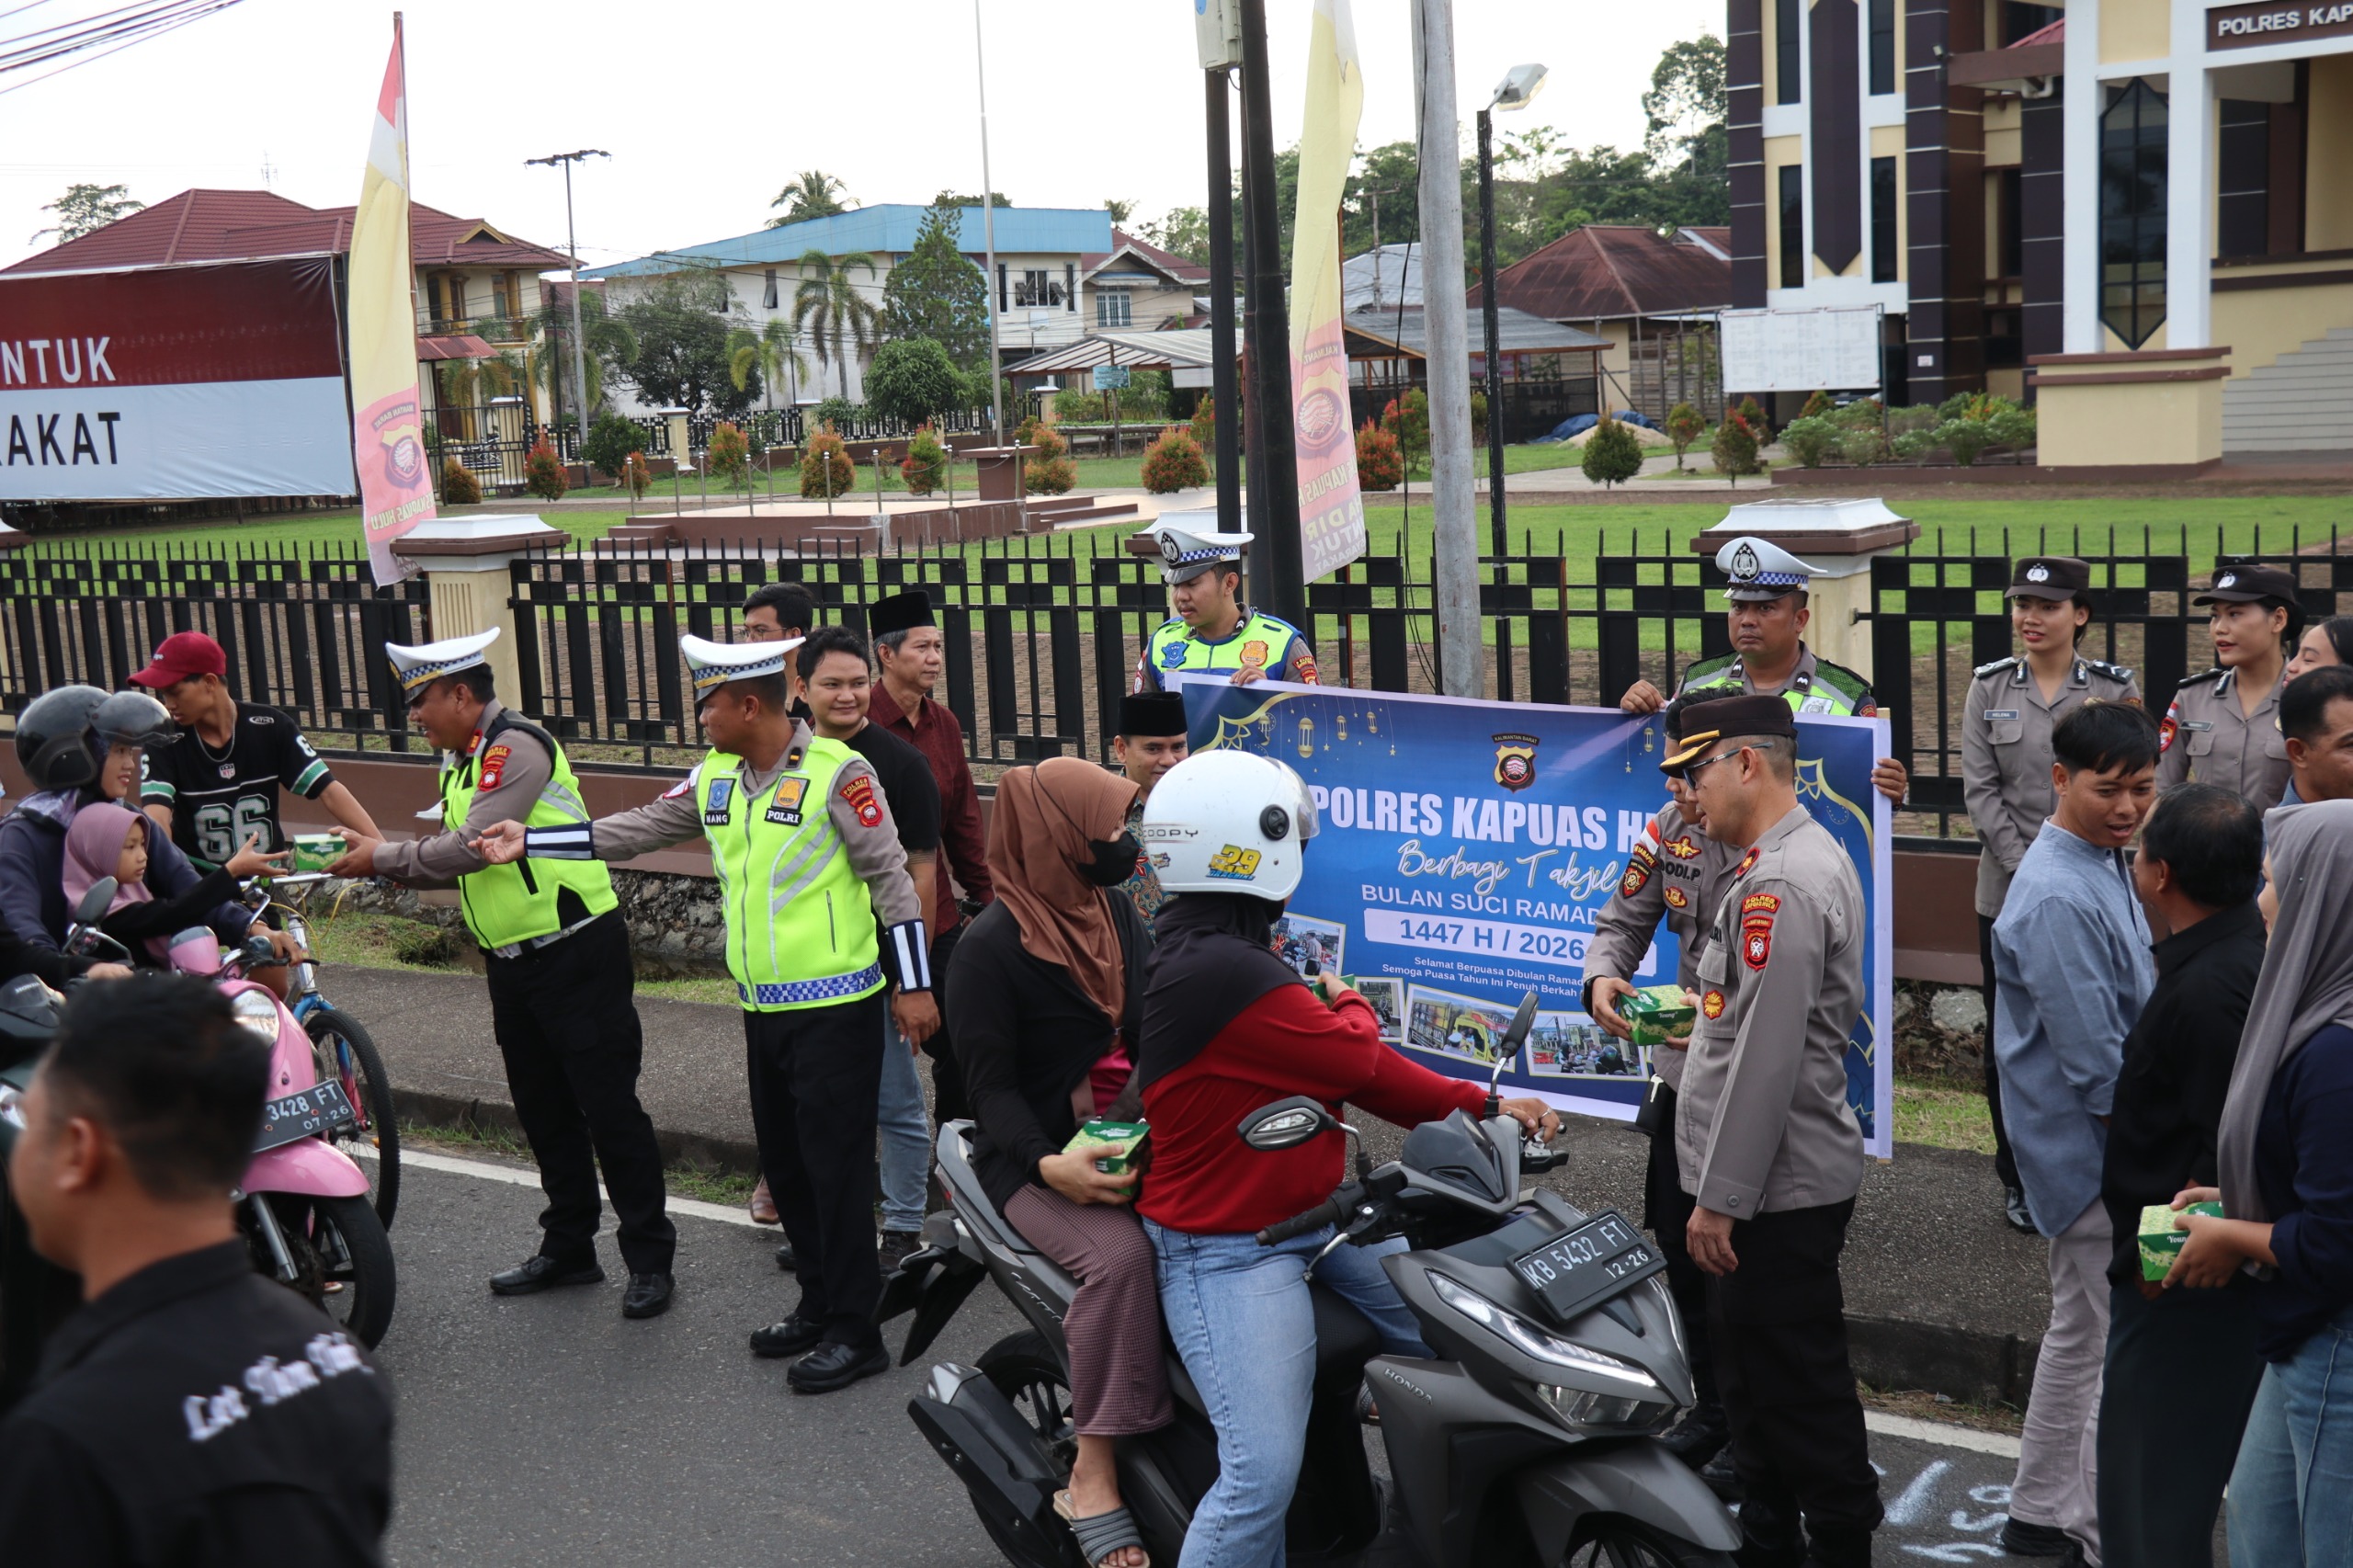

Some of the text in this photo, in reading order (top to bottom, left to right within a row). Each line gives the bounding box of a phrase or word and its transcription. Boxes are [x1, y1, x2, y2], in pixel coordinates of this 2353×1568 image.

[2218, 11, 2300, 37] POLRES
[0, 412, 120, 466] AKAT
[1522, 735, 1538, 744] BARAT
[194, 793, 274, 862] 66
[767, 810, 801, 824] POLRI
[1308, 784, 1443, 838] POLRES
[1451, 796, 1607, 853] KAPUAS
[1397, 839, 1619, 901] Berbagi Takjil
[1361, 884, 1443, 908] BULAN
[1450, 892, 1507, 915] SUCI
[1745, 895, 1776, 904] POLRES
[1400, 919, 1585, 960] 1447 H / 2026
[1382, 964, 1577, 997] Semoga Puasa Tahun Ini Penuh Berkah
[1414, 957, 1454, 970] Selamat
[1457, 962, 1505, 977] Berpuasa
[1506, 969, 1545, 982] Dibulan
[266, 1084, 337, 1120] 3428 FT
[1523, 1221, 1629, 1288] KB 5432 FT
[1384, 1367, 1433, 1405] HONDA
